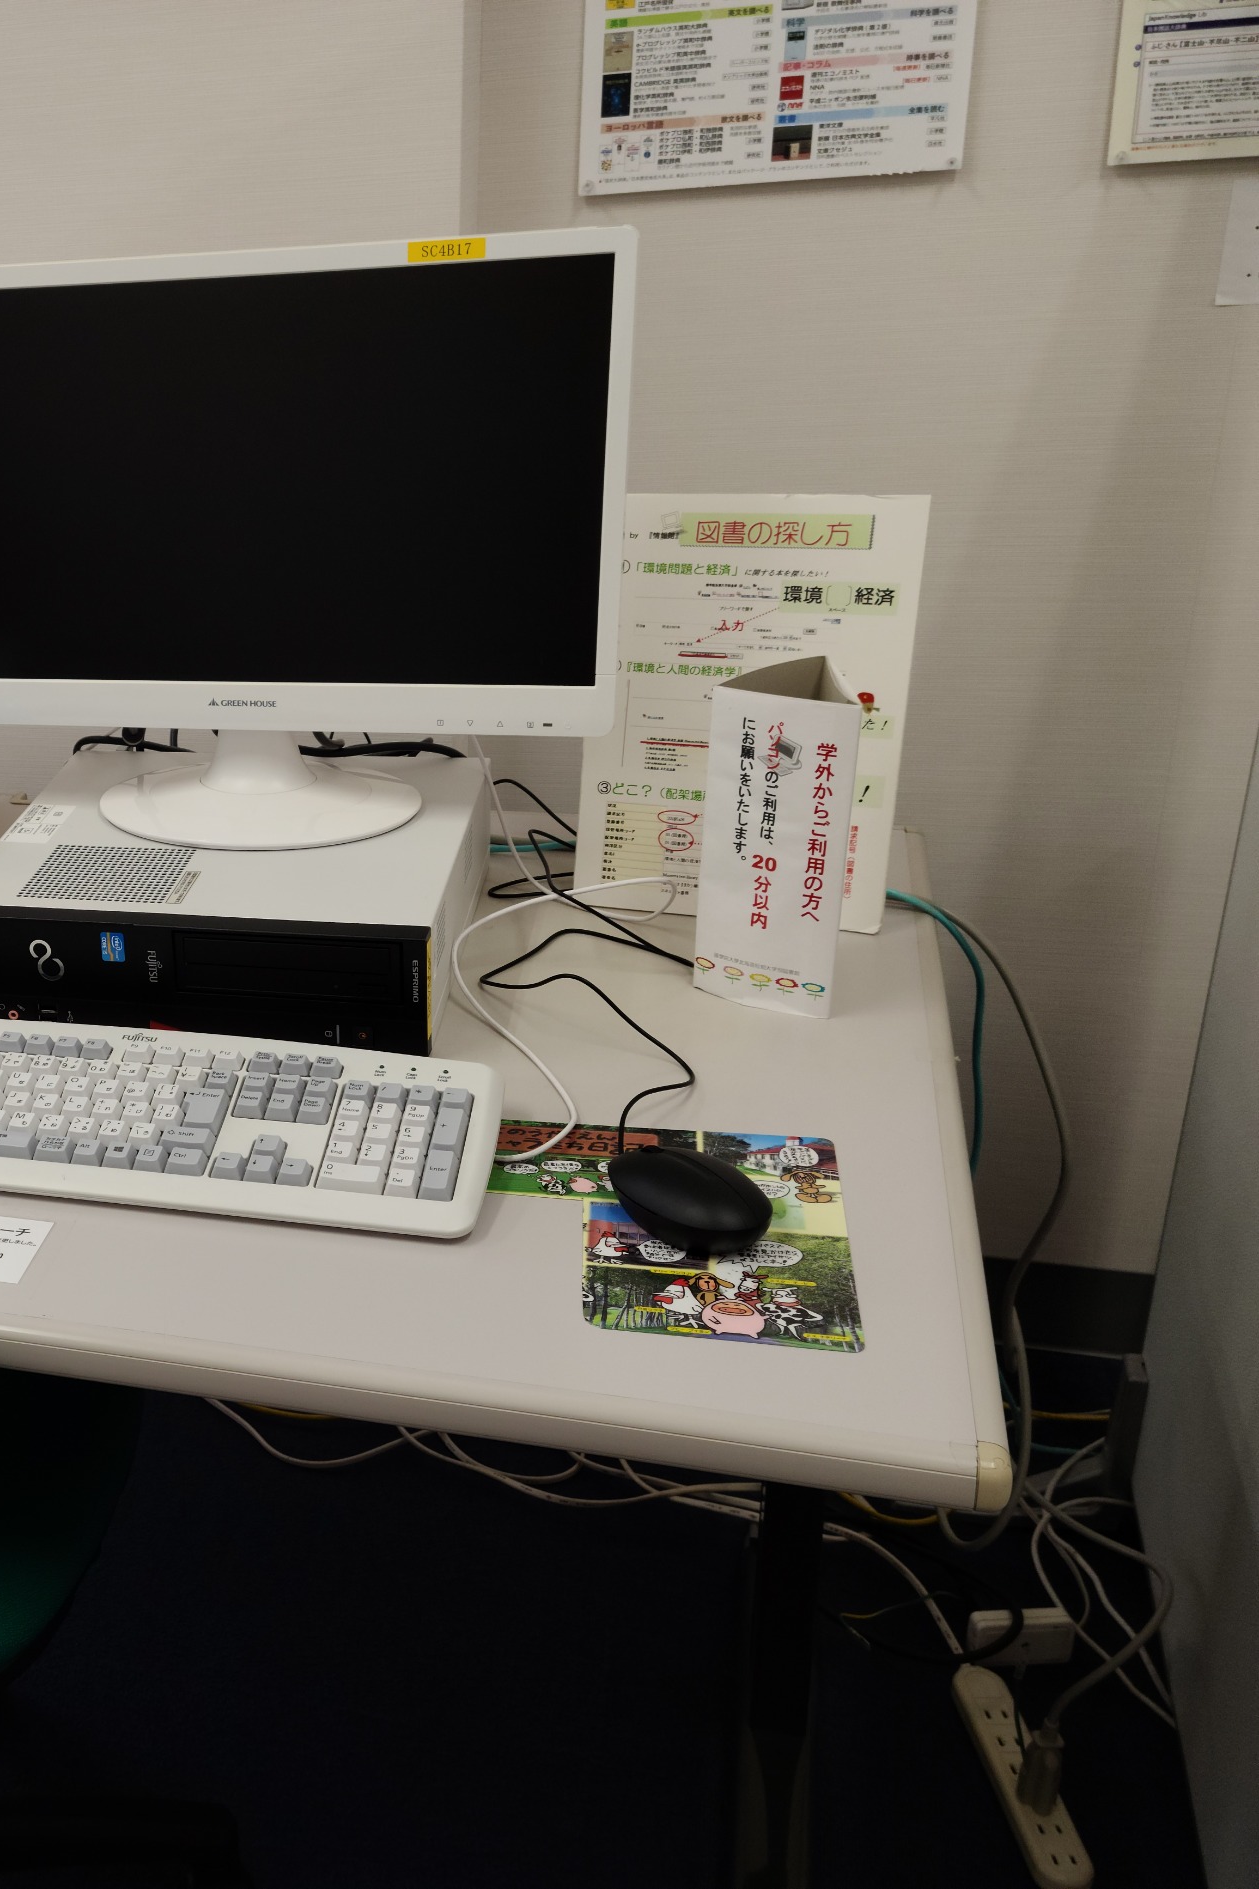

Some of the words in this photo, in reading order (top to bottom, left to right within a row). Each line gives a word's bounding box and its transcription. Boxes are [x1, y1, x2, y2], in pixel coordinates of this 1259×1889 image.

[728, 4, 770, 17] 英文を調べる
[910, 7, 953, 18] 科学を調べる
[786, 18, 806, 28] 科学
[634, 79, 671, 87] CAMBRIDGE
[421, 243, 472, 258] SC4B17
[629, 532, 639, 540] by
[695, 520, 852, 547] 図書の探し方
[635, 562, 739, 577] 「環境問題と経済」
[783, 585, 823, 605] 環境
[854, 587, 895, 607] 経済
[221, 699, 249, 707] GREEN
[249, 700, 277, 708] HOUSE
[732, 717, 756, 861] にお願いをいたします。
[759, 721, 786, 846] パソコンのご利用は、
[660, 787, 706, 802] （配架場
[801, 742, 838, 923] 学外からご利用の方へ
[145, 950, 159, 983] FUJITSU
[412, 960, 420, 1003] ESPRIMO
[122, 1033, 158, 1043] FUJITSU
